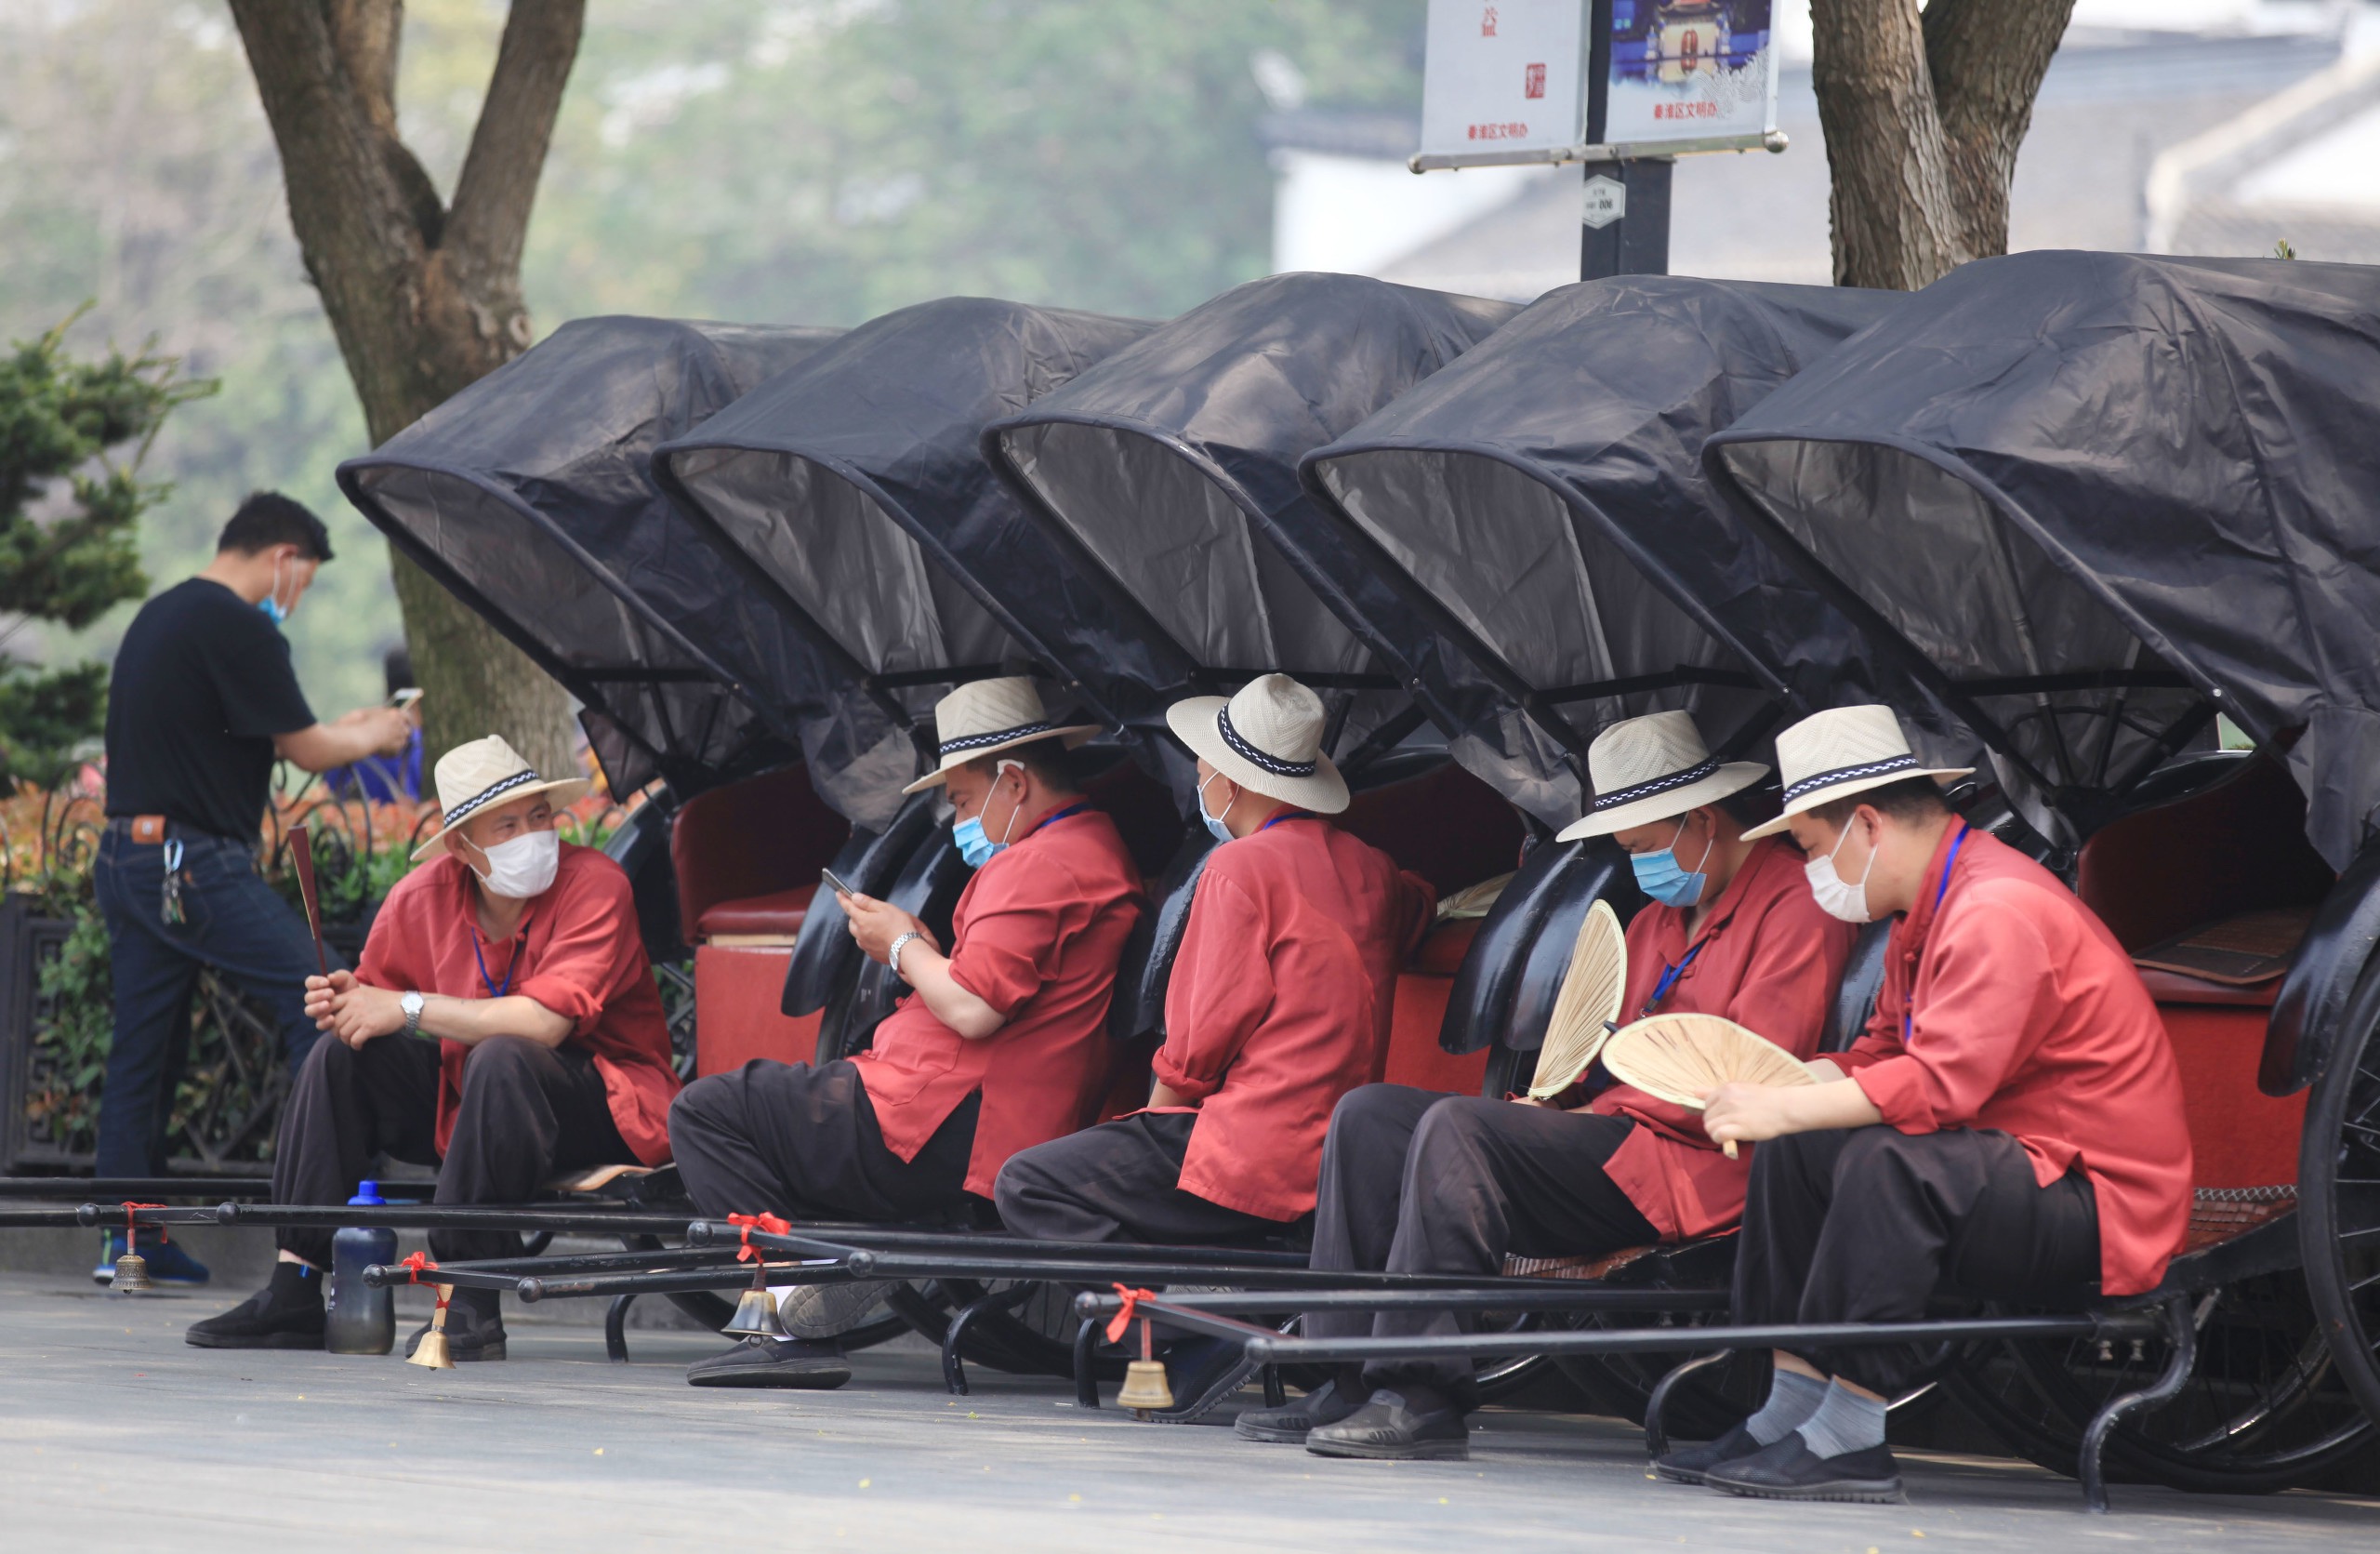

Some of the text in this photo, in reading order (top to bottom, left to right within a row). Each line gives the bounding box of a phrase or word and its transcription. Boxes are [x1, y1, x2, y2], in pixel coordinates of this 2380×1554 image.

[1482, 0, 1499, 37] 益
[1654, 101, 1717, 119] 秦淮区文明办
[1468, 123, 1527, 140] 秦淮区文明办
